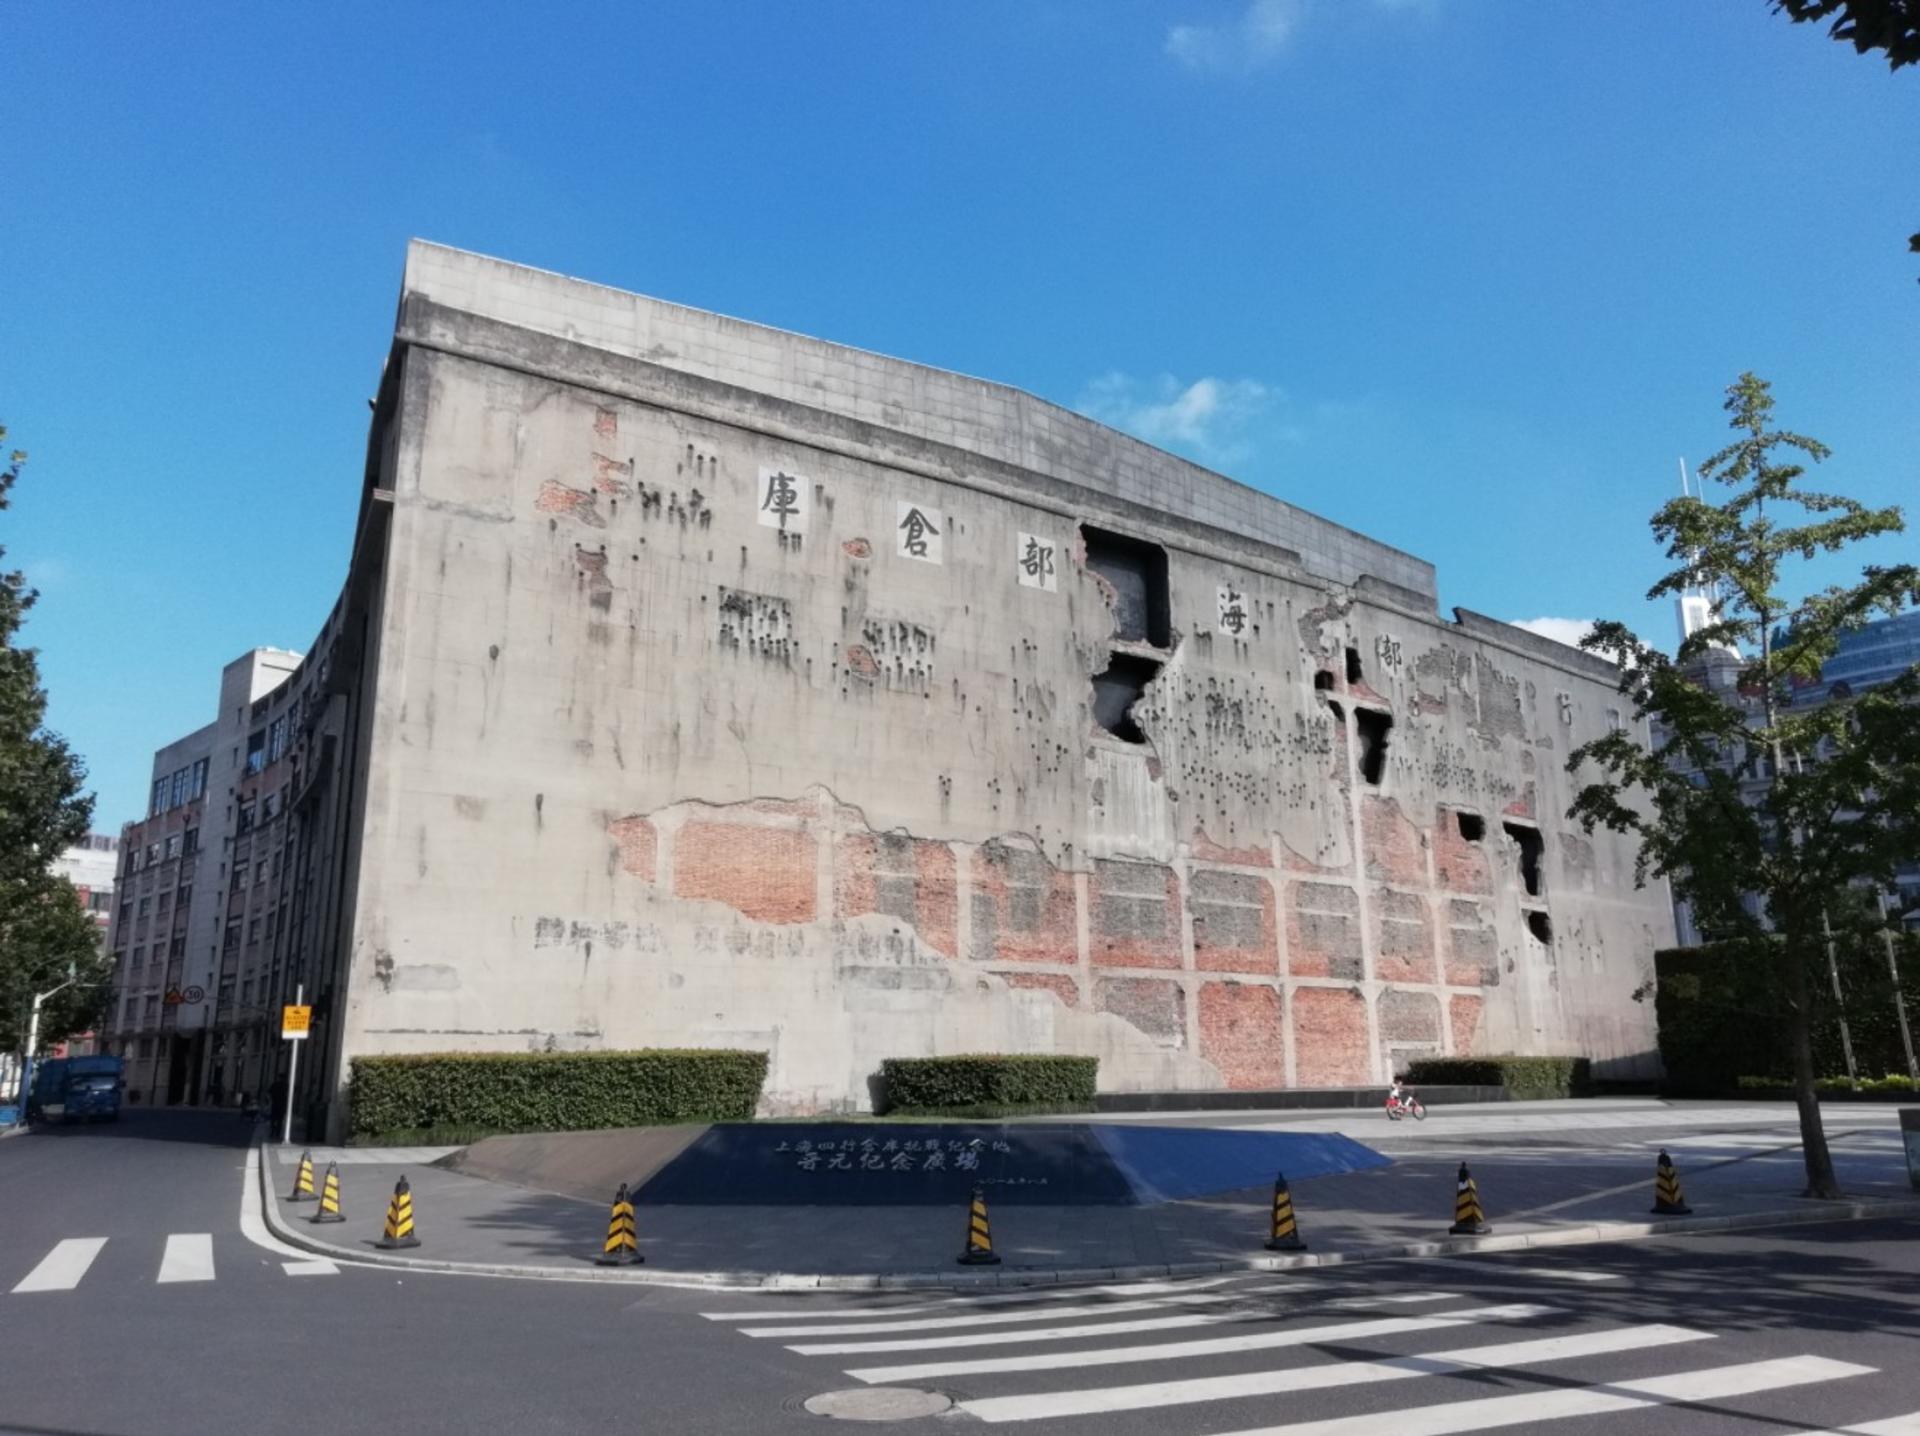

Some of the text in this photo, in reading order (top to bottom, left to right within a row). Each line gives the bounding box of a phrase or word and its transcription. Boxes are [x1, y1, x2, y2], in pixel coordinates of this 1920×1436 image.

[761, 471, 800, 528] 庫
[899, 507, 940, 557] 倉
[1019, 536, 1054, 587] 部
